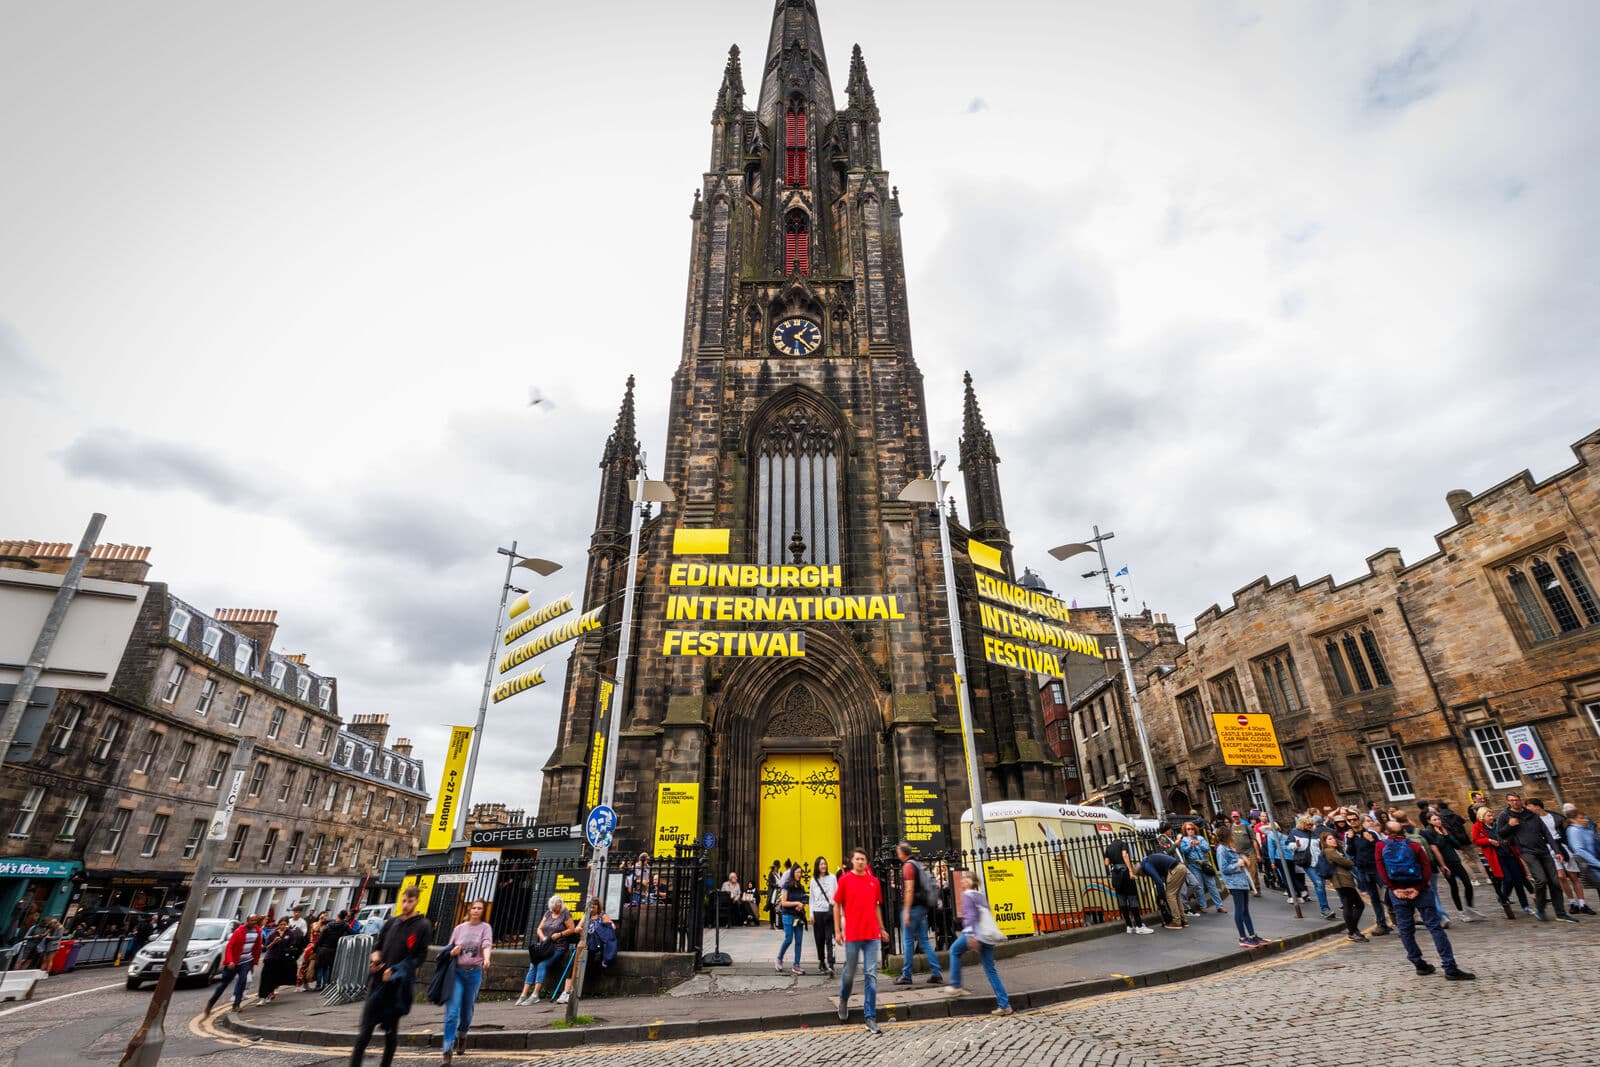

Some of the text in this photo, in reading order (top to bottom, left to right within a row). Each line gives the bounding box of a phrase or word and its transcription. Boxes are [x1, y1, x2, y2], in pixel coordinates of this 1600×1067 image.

[669, 564, 842, 587] EDINBURGH
[666, 596, 905, 620] INTERNATIONAL
[975, 571, 1070, 623] EDINBURGH
[979, 602, 1104, 659] INTERNATIONAL
[663, 631, 806, 656] FESTIVAL
[983, 636, 1065, 678] FESTIVAL
[438, 795, 453, 832] AUGUST
[1058, 808, 1108, 819] Ice Cream
[473, 826, 569, 843] COFFEE & BEER
[18, 863, 50, 874] Kitchen
[994, 903, 1013, 912] 4-27
[996, 912, 1026, 922] AUGUST
